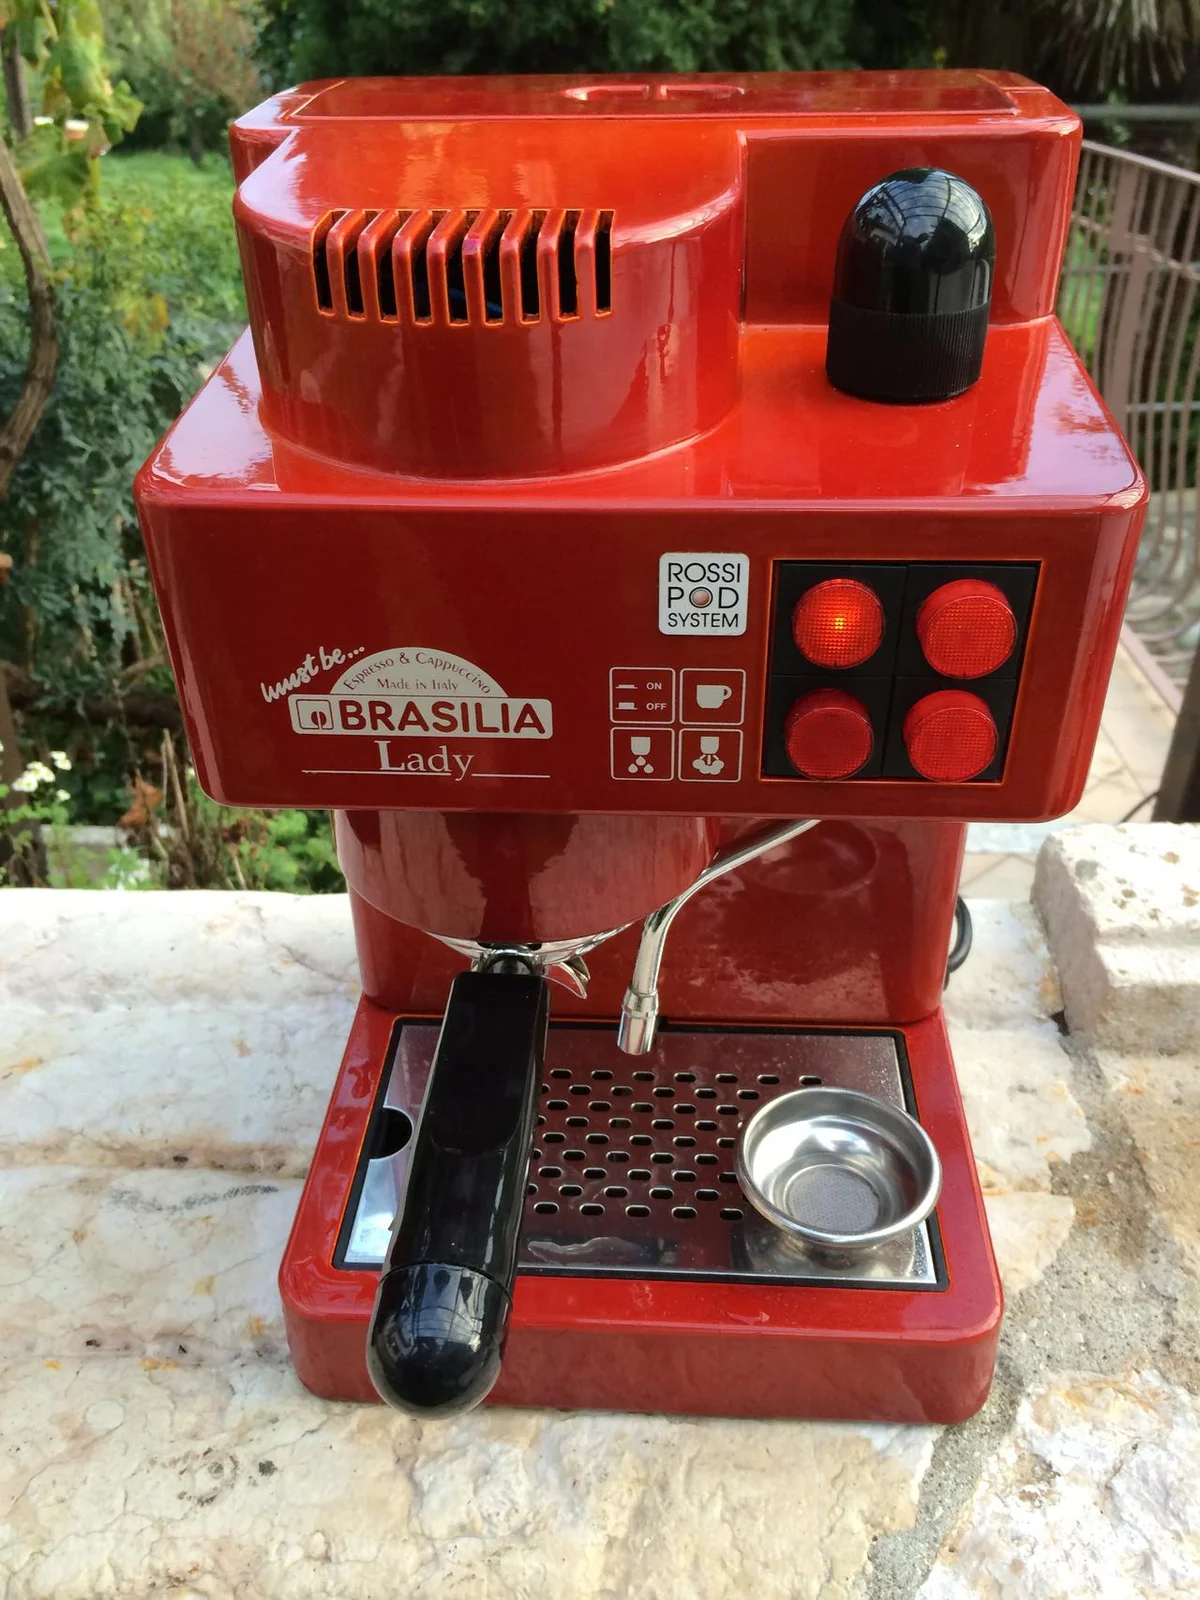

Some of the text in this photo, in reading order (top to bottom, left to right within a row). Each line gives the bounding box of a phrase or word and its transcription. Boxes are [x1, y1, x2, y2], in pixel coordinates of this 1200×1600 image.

[668, 562, 741, 583] ROSSI
[668, 586, 740, 609] POD
[667, 612, 739, 628] SYSTEM
[399, 651, 411, 665] &
[415, 651, 491, 694] Cappuccino
[376, 678, 459, 691] Made in Italy
[646, 682, 662, 691] ON
[338, 699, 546, 735] BRASILIA
[646, 702, 667, 711] OFF
[374, 740, 474, 781] Lady
